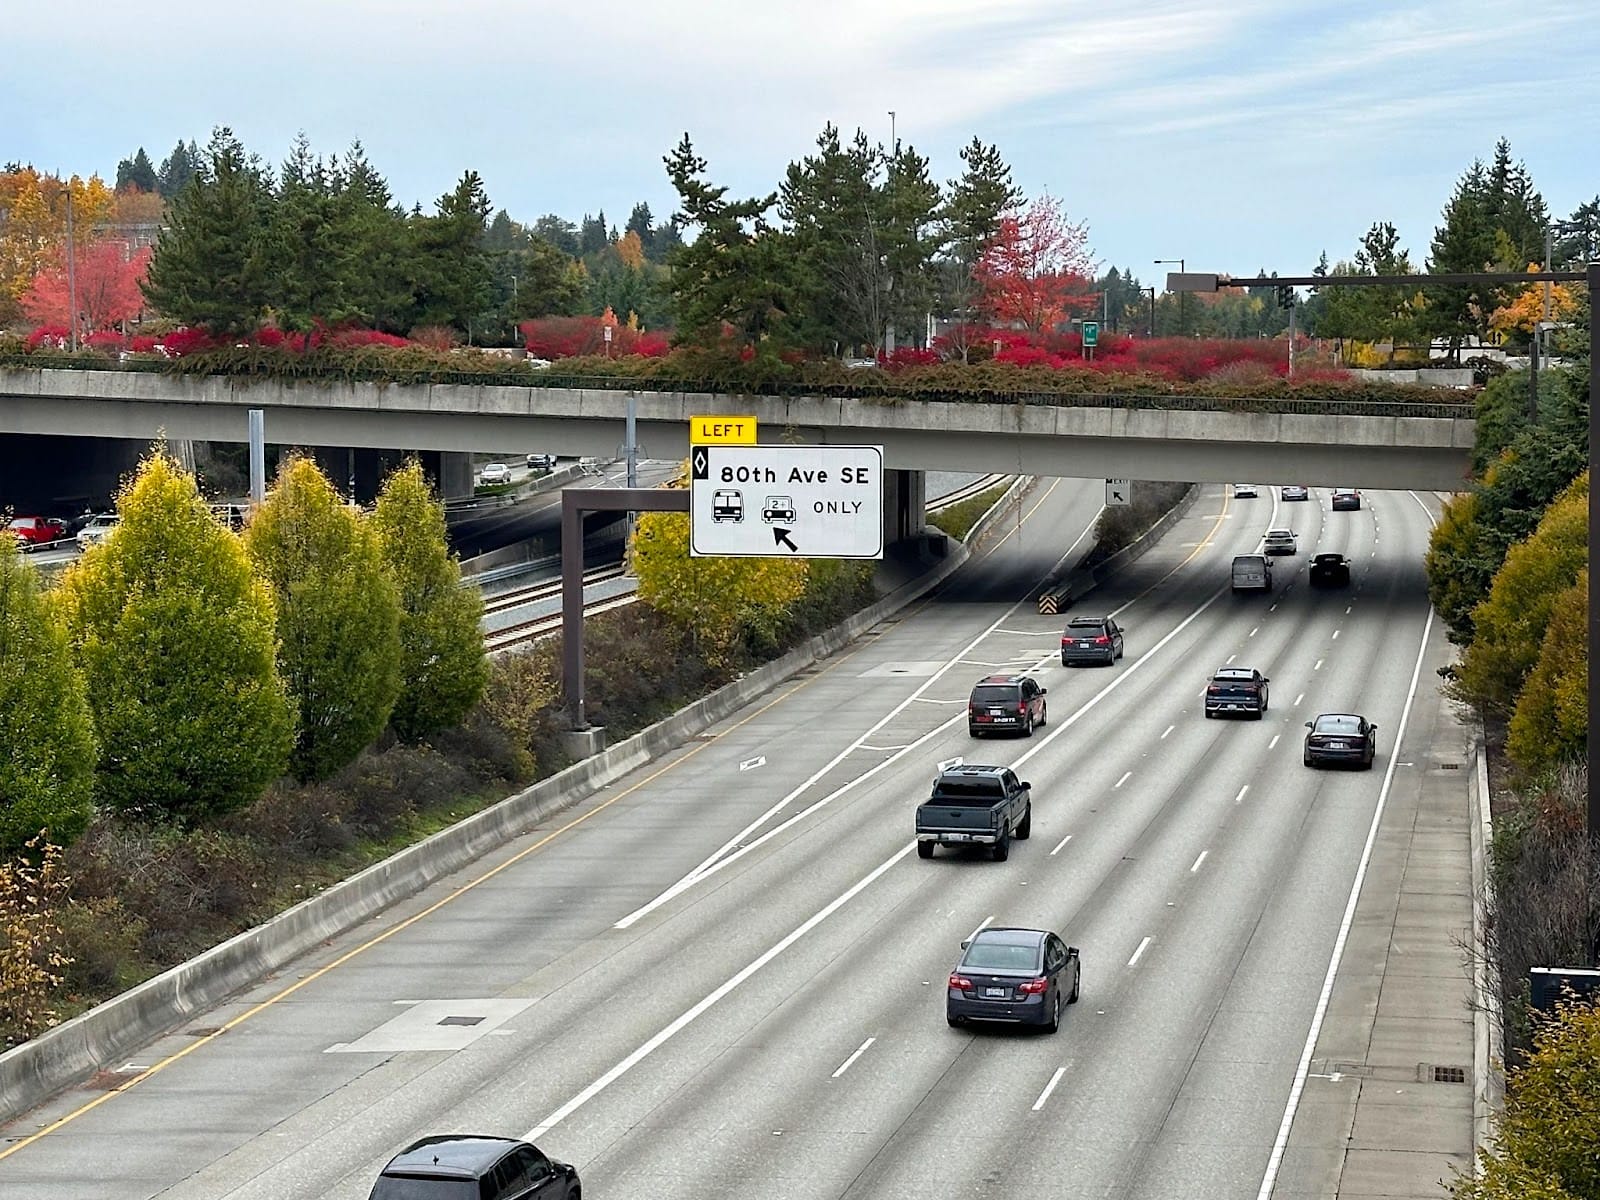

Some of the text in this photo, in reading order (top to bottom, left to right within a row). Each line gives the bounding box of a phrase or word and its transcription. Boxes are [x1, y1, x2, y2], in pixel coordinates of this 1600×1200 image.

[703, 424, 744, 437] LEFT
[721, 466, 869, 484] 80th Ave SE
[813, 501, 862, 514] ONLY
